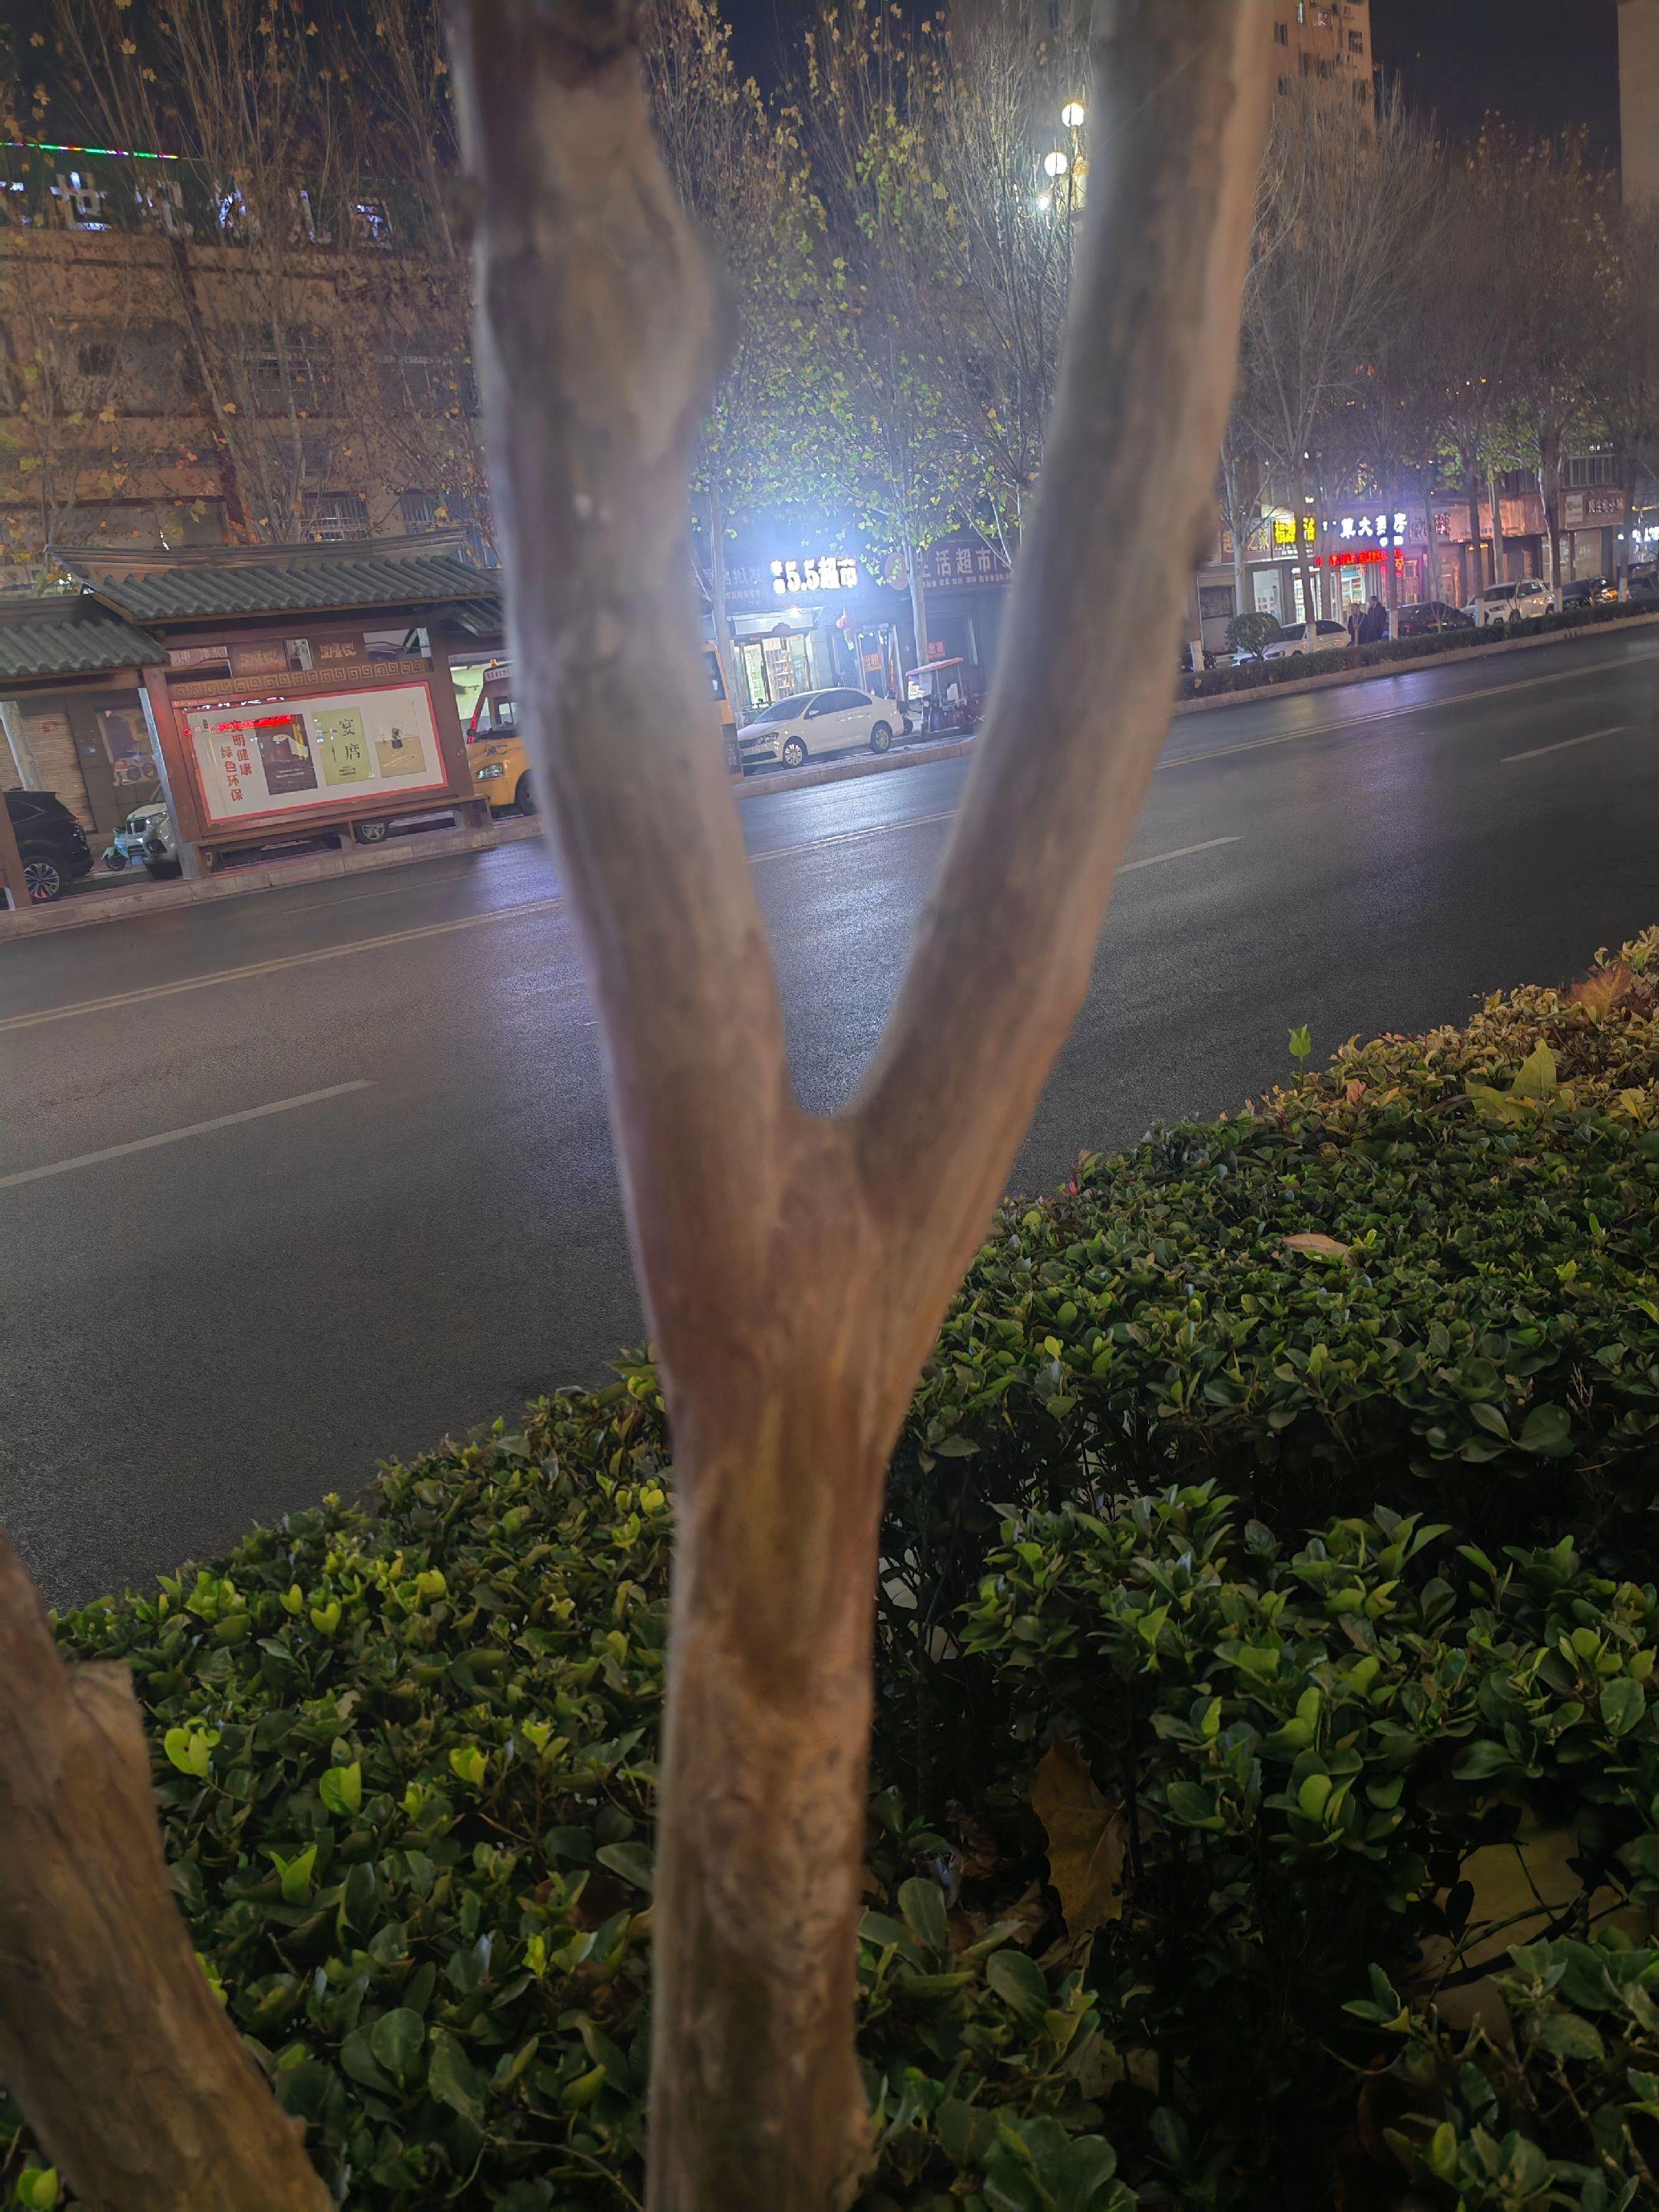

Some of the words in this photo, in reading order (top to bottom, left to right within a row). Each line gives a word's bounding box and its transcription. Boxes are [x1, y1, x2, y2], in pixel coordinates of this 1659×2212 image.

[232, 720, 253, 776] 明健康
[339, 718, 360, 760] 宴席
[220, 746, 243, 802] 绿色环保
